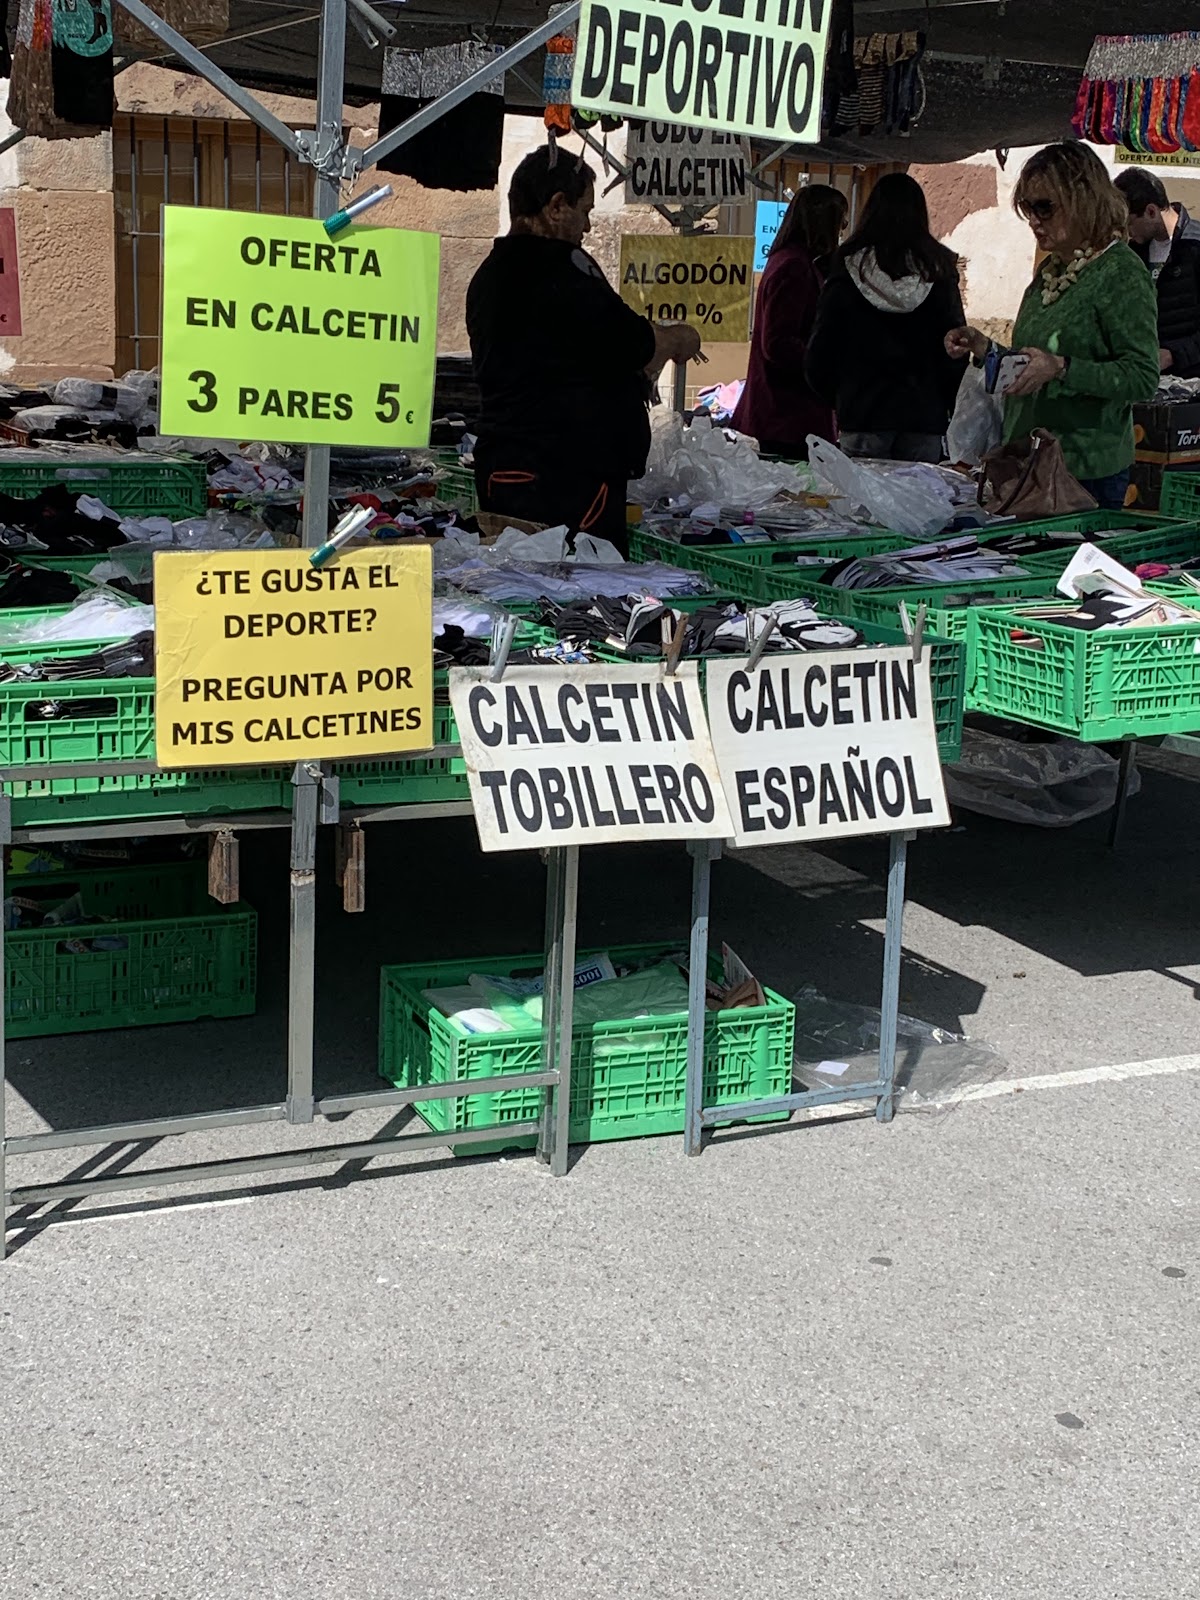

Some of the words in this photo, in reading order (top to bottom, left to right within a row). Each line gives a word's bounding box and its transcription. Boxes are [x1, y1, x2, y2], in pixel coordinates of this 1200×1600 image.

[580, 3, 815, 134] DEPORTIVO
[631, 157, 745, 196] CALCETIN
[1119, 153, 1153, 162] OFERTA
[1156, 155, 1168, 163] EN
[240, 236, 382, 277] OFERTA
[623, 256, 747, 285] ALGODÓN
[186, 297, 237, 329] EN
[251, 302, 420, 343] CALCETIN
[645, 303, 687, 323] 100
[696, 303, 723, 324] %
[186, 370, 218, 413] 3
[238, 386, 353, 421] PARES
[196, 570, 250, 595] ¿TE
[261, 566, 359, 594] GUSTA
[368, 565, 398, 588] EL
[224, 608, 377, 639] DEPORTE?
[182, 671, 348, 703] PREGUNTA
[357, 666, 413, 693] POR
[172, 720, 234, 745] MIS
[244, 707, 422, 743] CALCETINES
[468, 681, 695, 747] CALCETIN
[479, 762, 715, 834] TOBILLERO
[735, 745, 933, 833] ESPAÑOL
